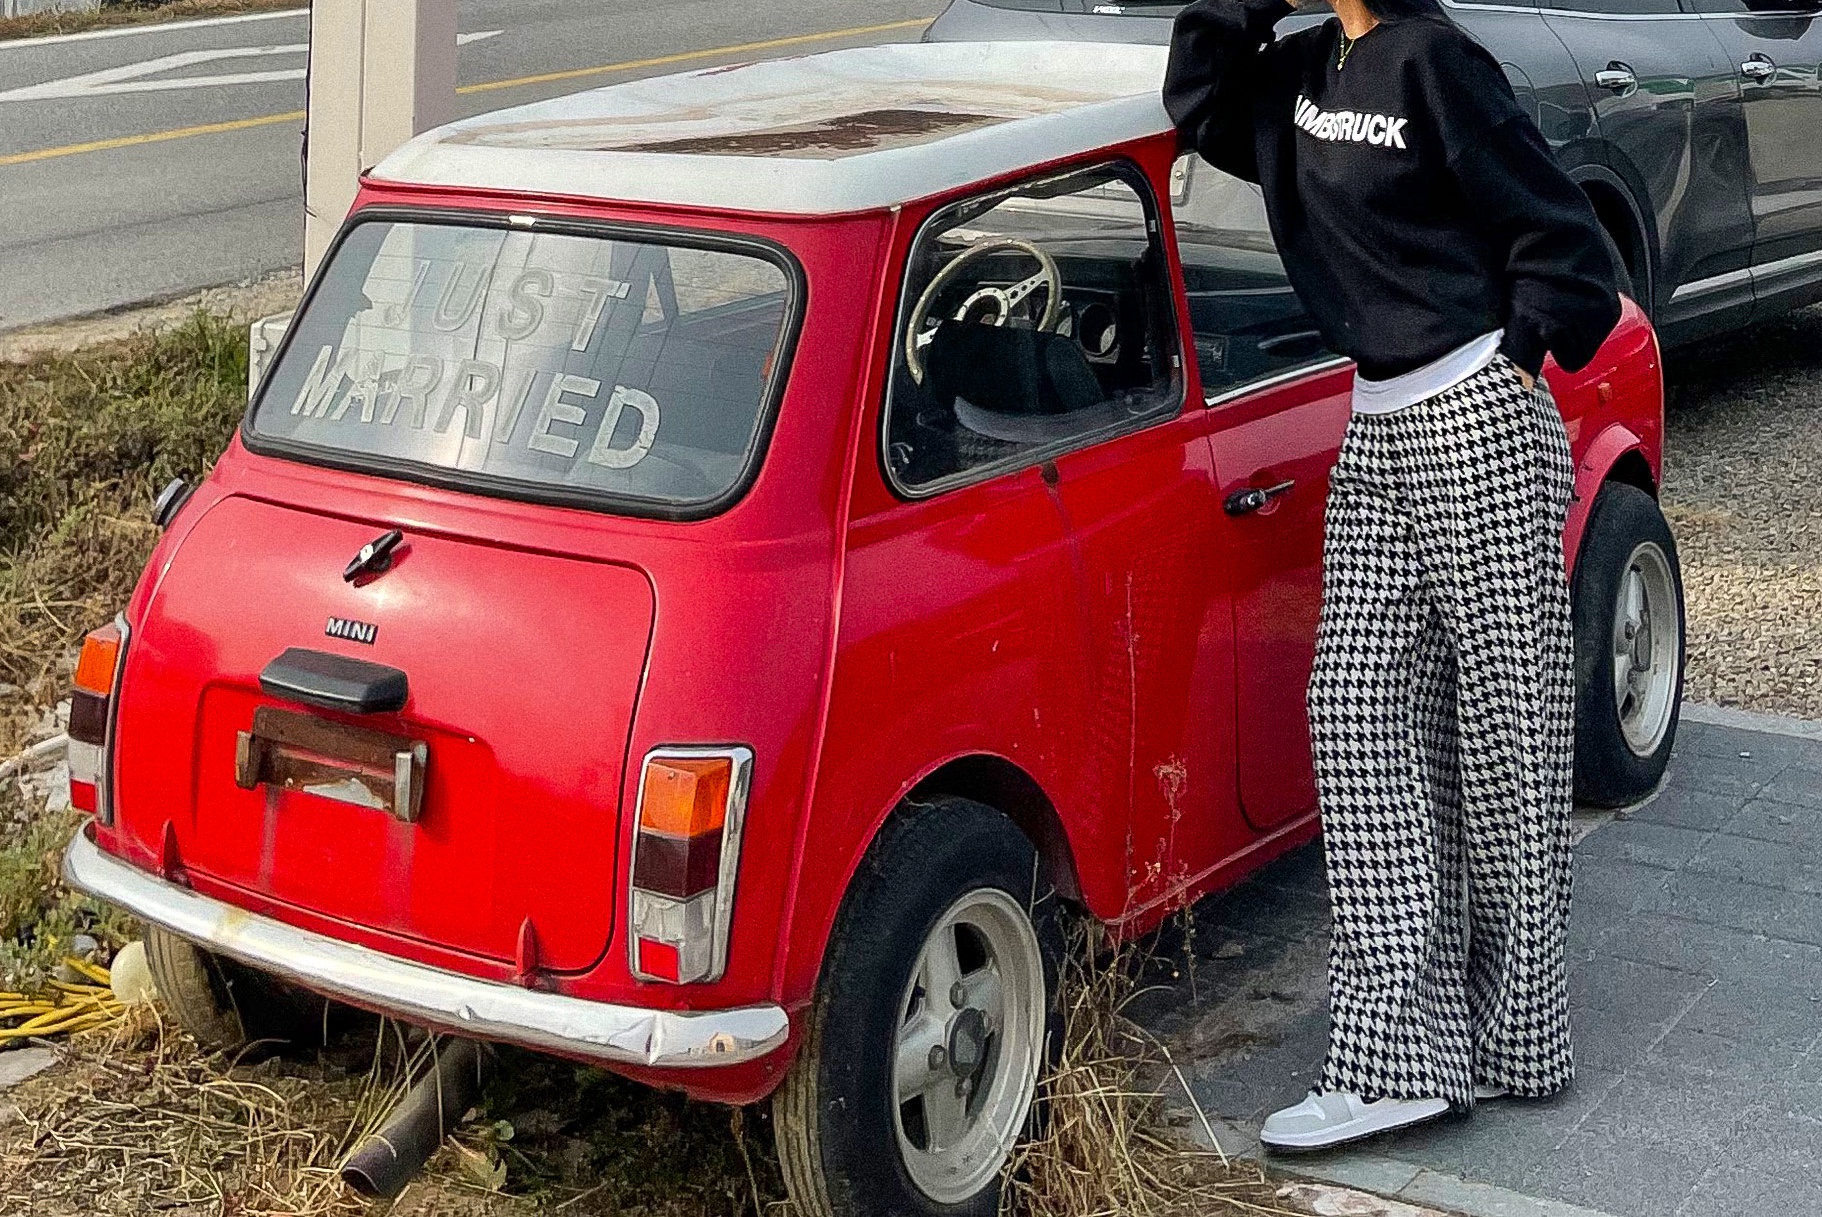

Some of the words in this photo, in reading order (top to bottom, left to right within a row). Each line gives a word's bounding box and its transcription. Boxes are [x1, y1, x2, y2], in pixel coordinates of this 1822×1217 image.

[383, 259, 632, 352] JUST
[290, 344, 661, 470] MARRIED
[325, 616, 376, 643] MINI
